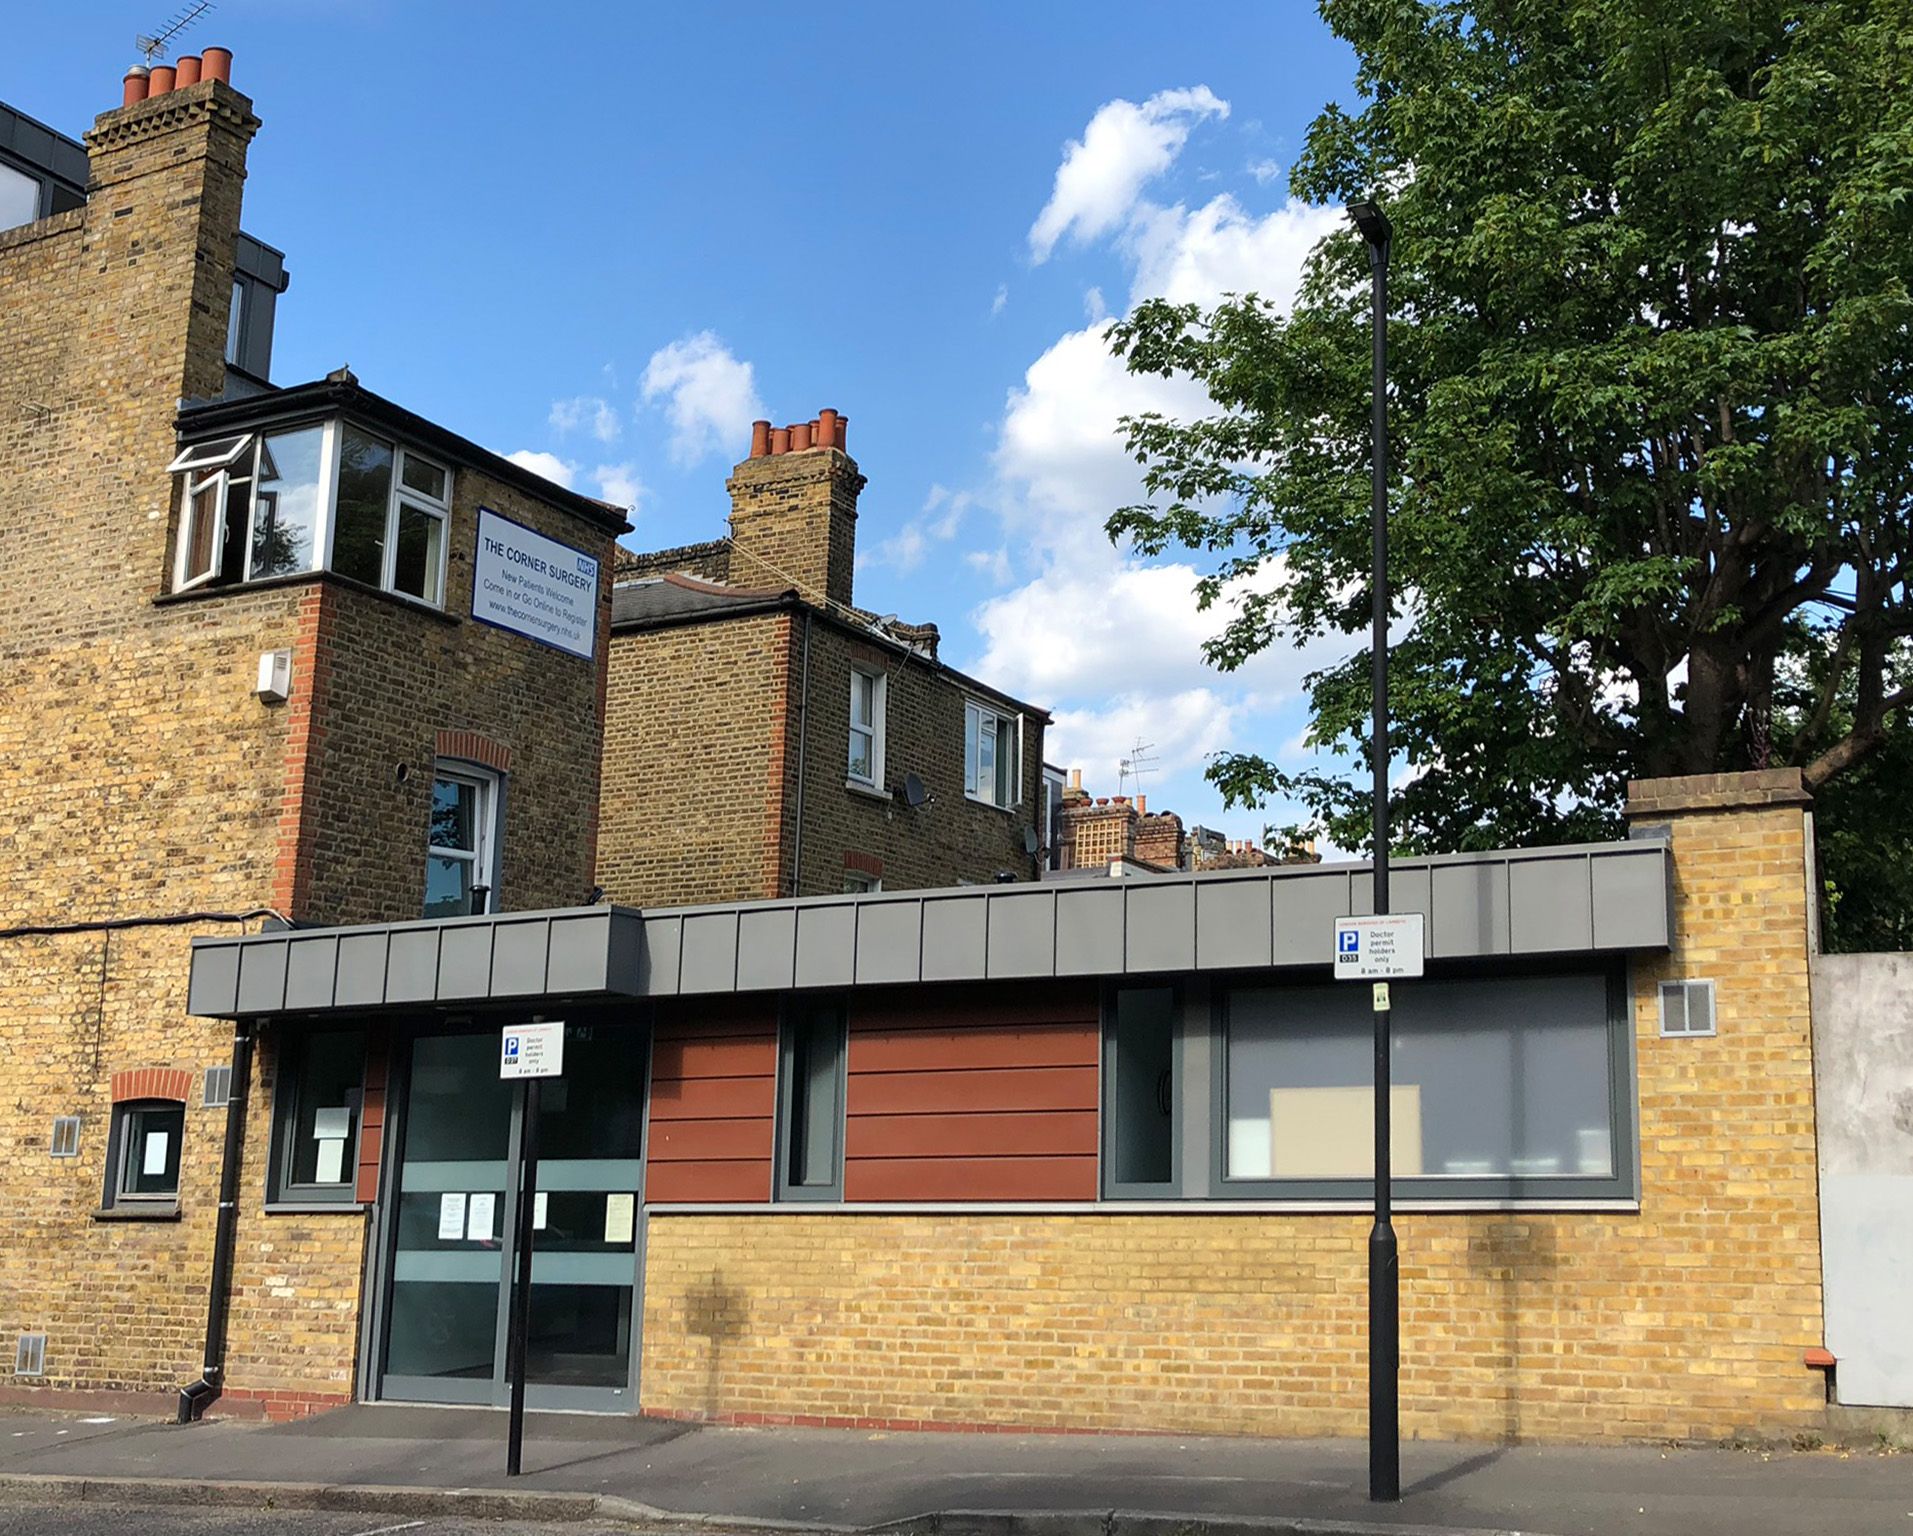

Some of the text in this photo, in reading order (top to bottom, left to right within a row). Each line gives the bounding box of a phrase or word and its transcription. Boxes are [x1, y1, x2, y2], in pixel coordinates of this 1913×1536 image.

[484, 537, 592, 593] THE CORNER SURGERY
[578, 558, 595, 577] NHS
[502, 569, 574, 606] New Patients Welcome
[483, 578, 587, 627] Come in or Go Online to Register
[1343, 932, 1357, 951] P
[1369, 947, 1395, 955] holders
[508, 1038, 518, 1054] P
